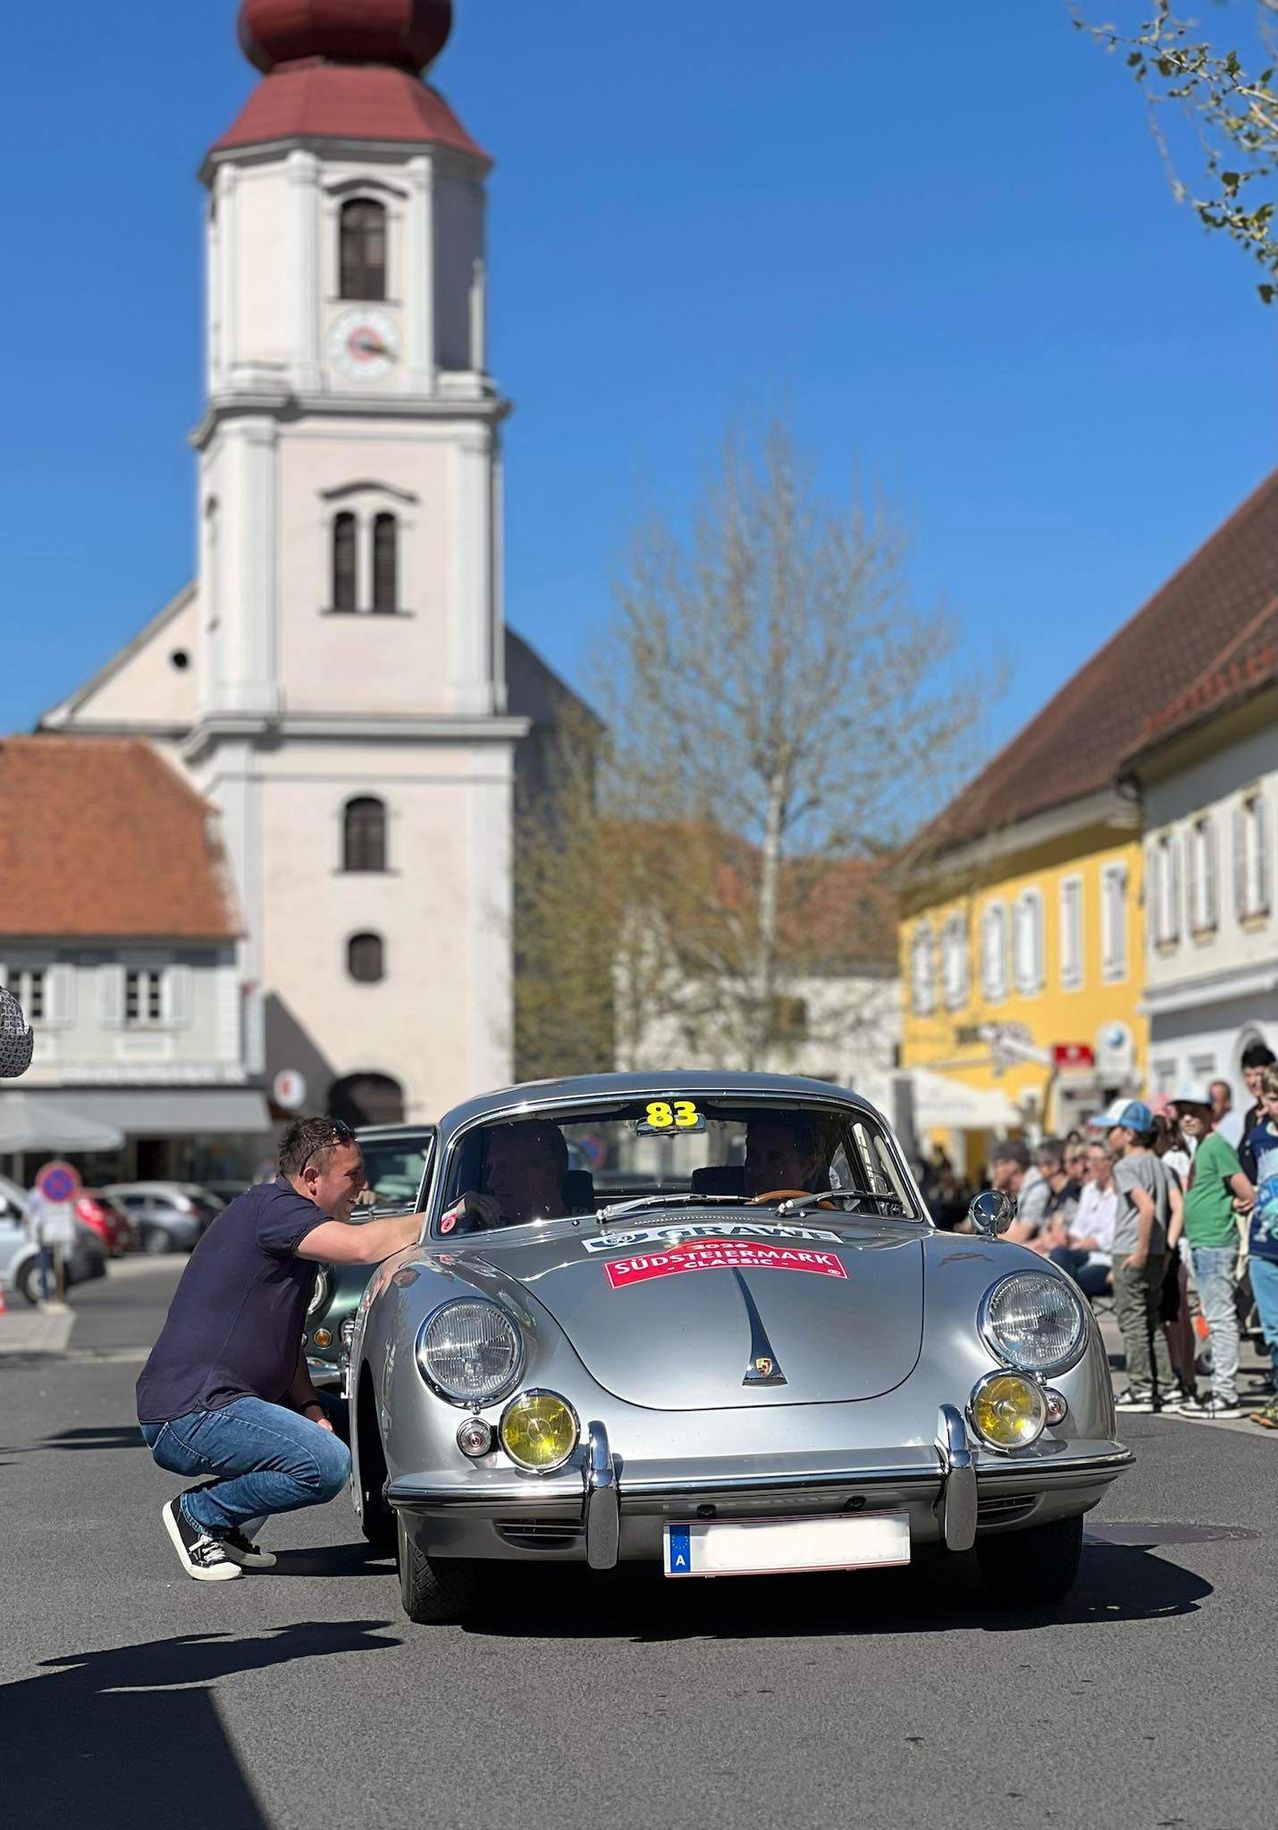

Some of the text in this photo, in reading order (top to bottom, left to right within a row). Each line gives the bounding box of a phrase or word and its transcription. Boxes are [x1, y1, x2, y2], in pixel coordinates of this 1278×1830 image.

[646, 1101, 699, 1128] 83
[657, 1225, 834, 1241] GRAWE
[614, 1250, 834, 1275] SÜDSTEIERMARK
[683, 1258, 774, 1268] CLASSIC
[675, 1554, 686, 1566] A
